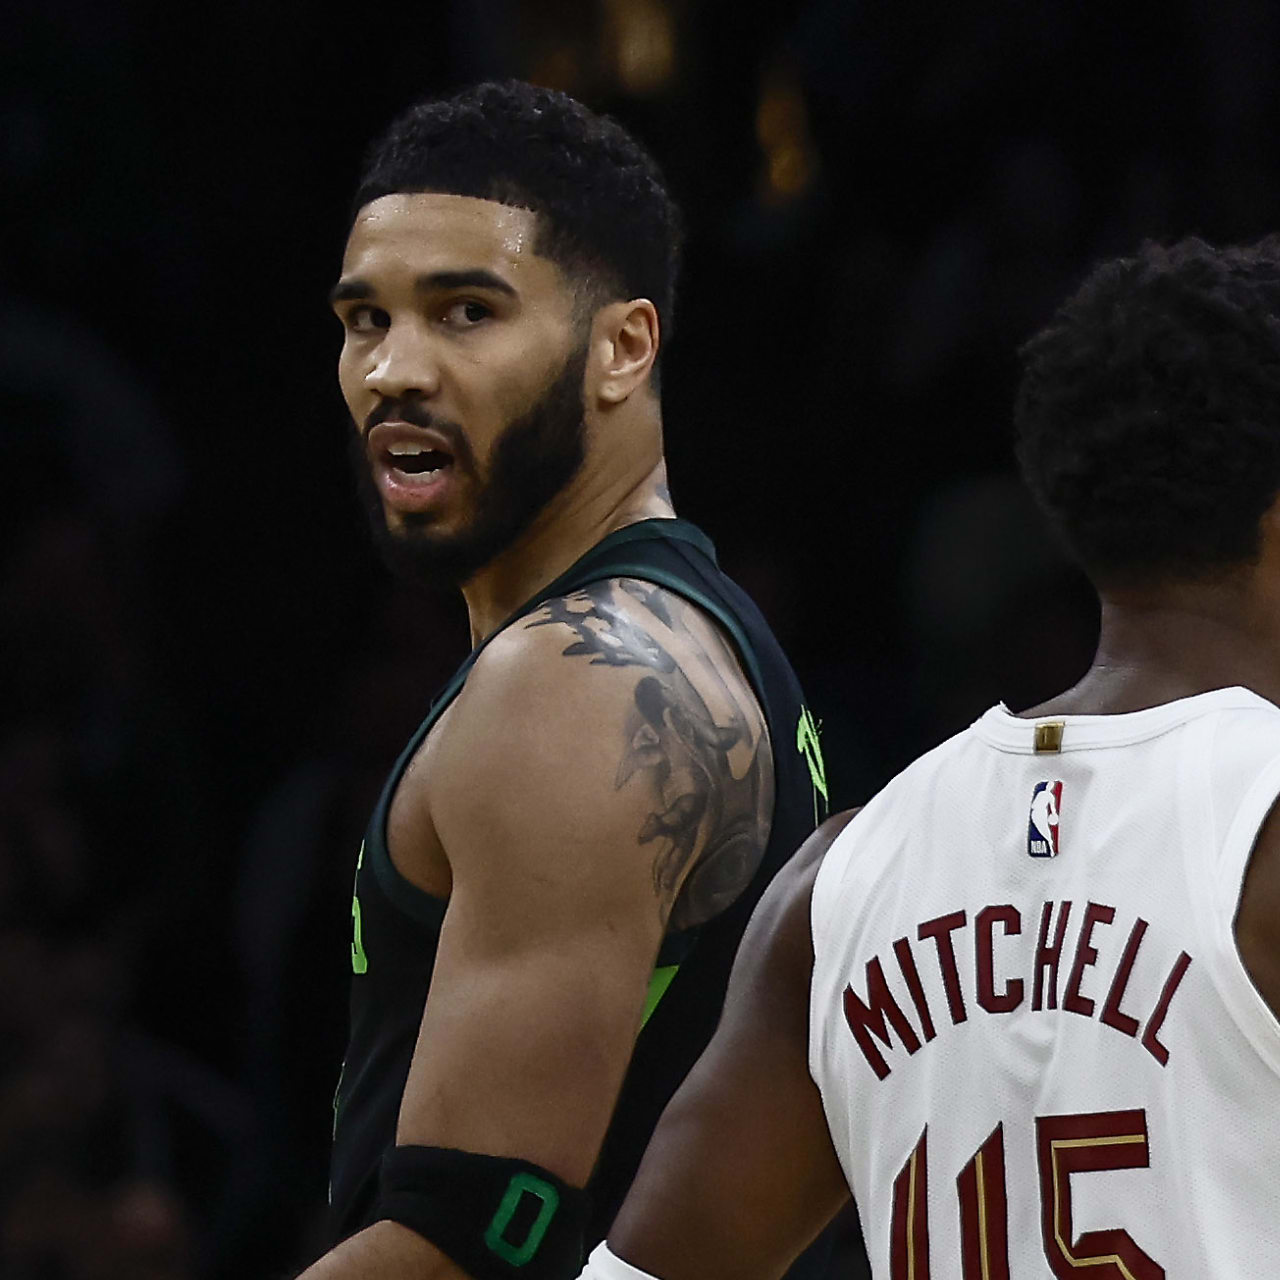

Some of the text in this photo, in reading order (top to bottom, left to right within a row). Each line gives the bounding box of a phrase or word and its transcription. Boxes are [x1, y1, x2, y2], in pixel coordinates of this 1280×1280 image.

[1030, 840, 1047, 854] NBA
[843, 901, 1192, 1081] MITCHELL
[484, 1172, 559, 1267] 0
